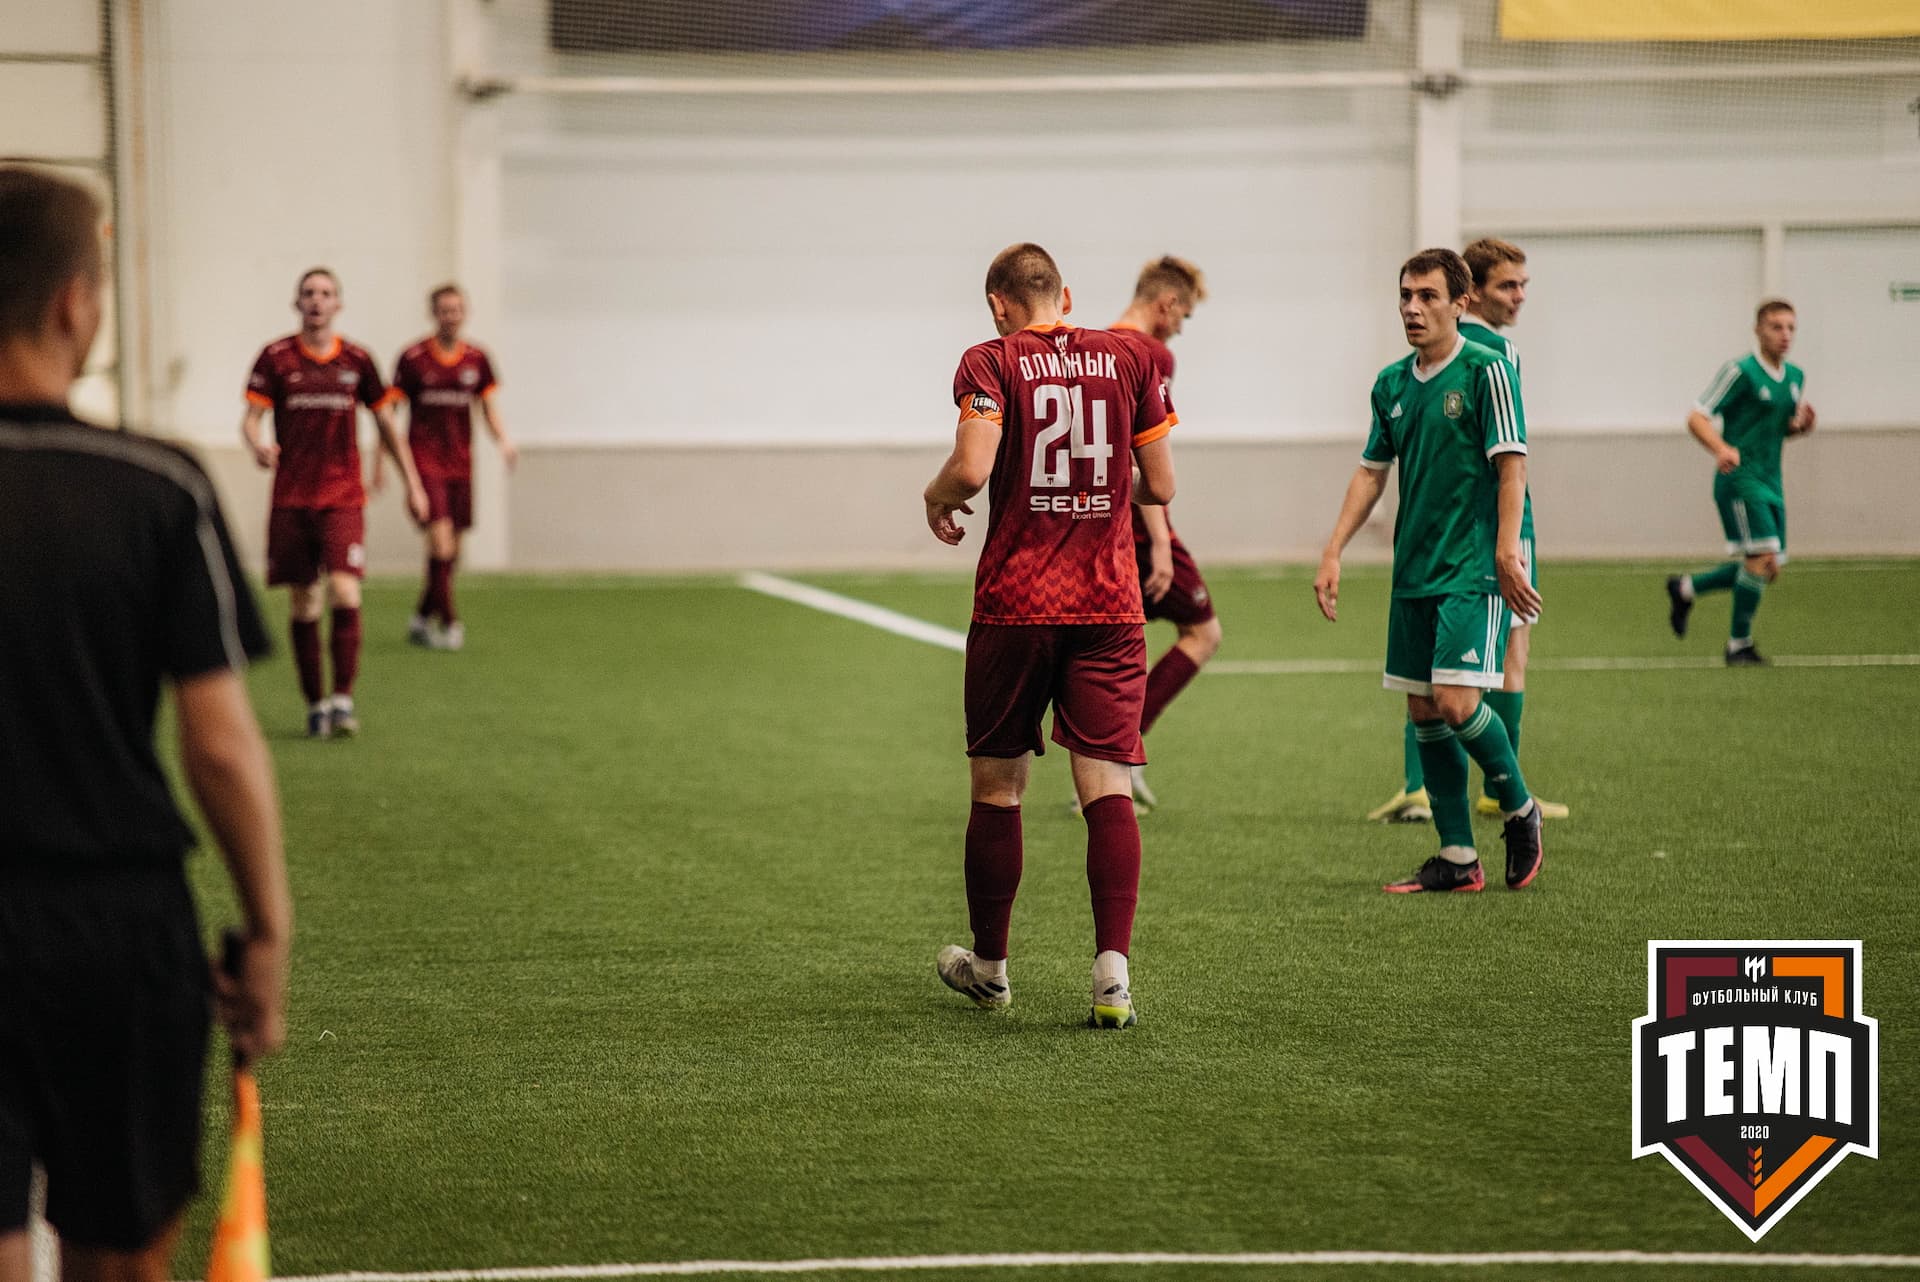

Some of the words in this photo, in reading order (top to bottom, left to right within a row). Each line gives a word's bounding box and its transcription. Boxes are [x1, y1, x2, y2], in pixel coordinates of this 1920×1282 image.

[1019, 349, 1117, 381] ОЛИЙНЫК
[973, 397, 998, 411] ТЕМП
[1030, 384, 1113, 488] 24
[1092, 511, 1111, 519] Union
